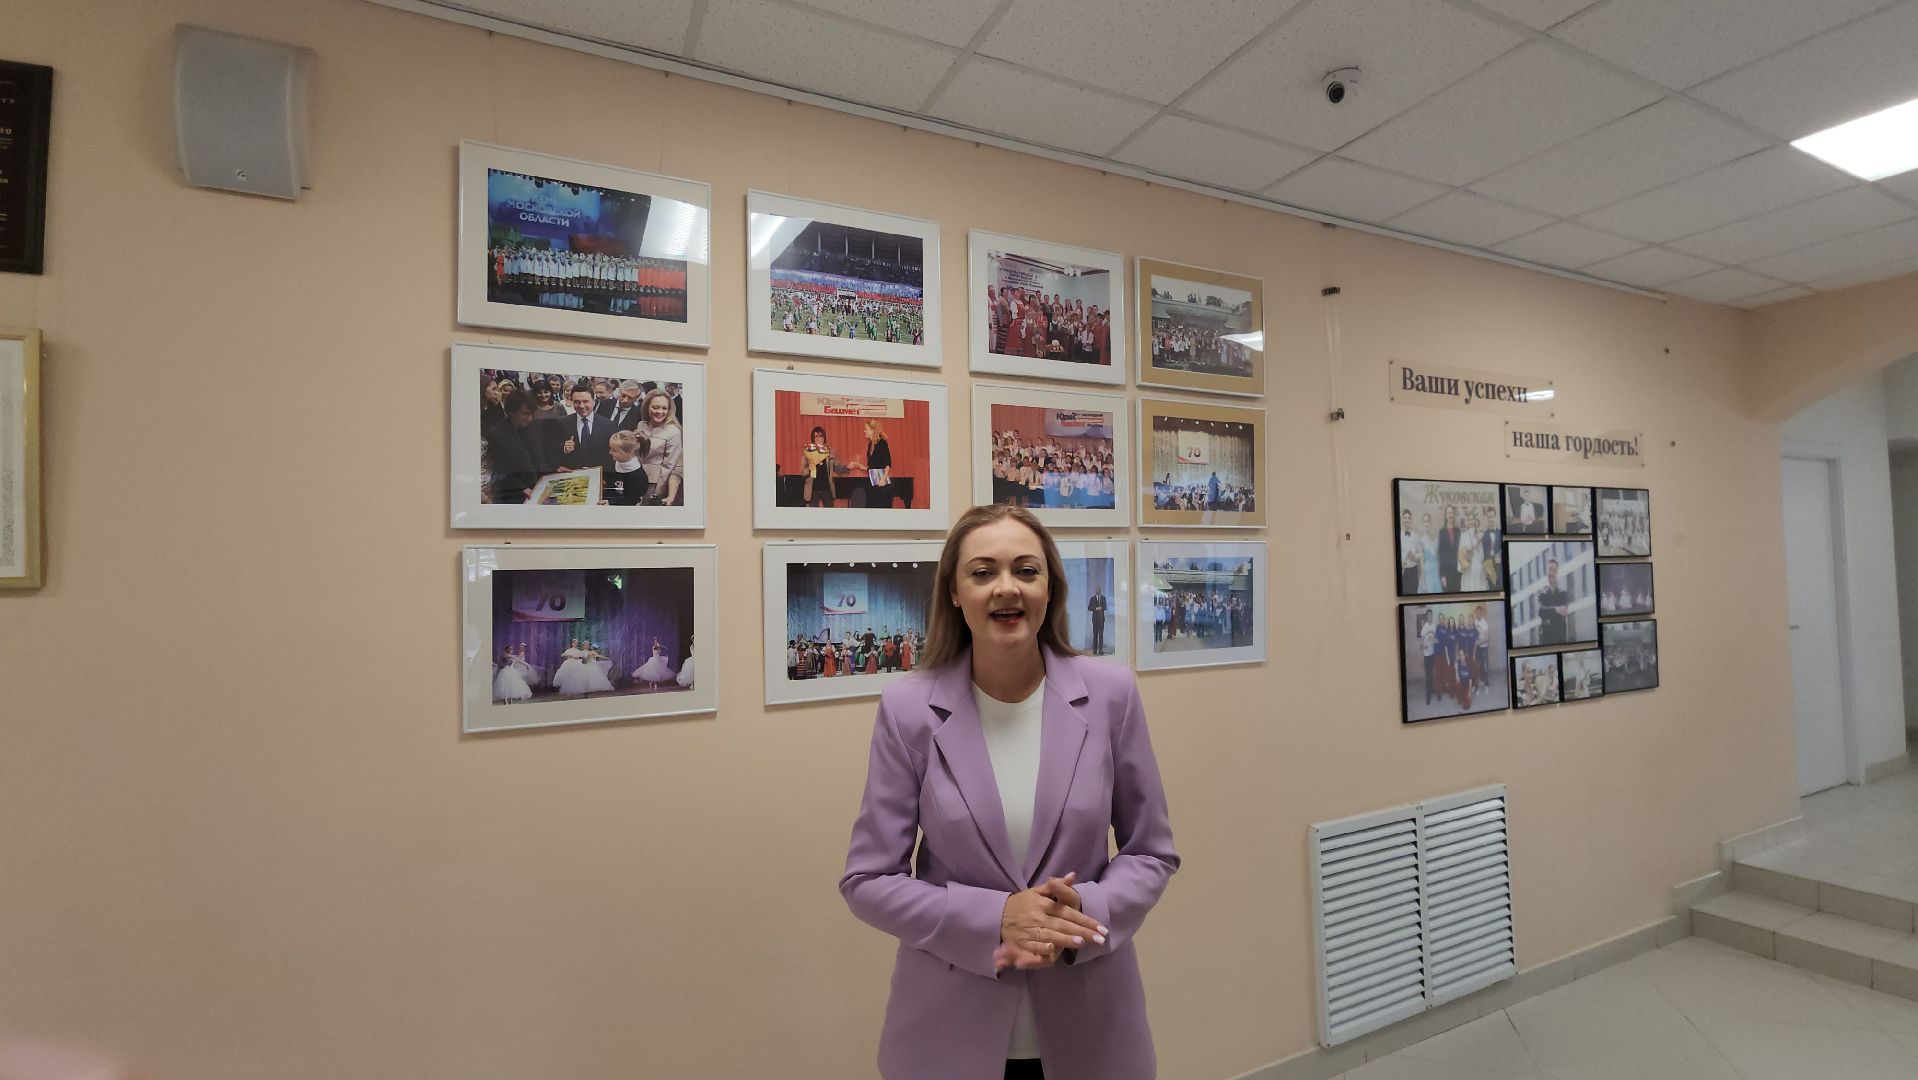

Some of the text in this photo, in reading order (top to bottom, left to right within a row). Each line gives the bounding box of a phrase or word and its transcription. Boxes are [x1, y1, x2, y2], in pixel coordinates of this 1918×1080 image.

[519, 212, 571, 228] ОБЛАСТИ
[1401, 365, 1529, 405] Ваши успехи
[1512, 429, 1639, 460] наша гордость!
[838, 592, 857, 608] 70
